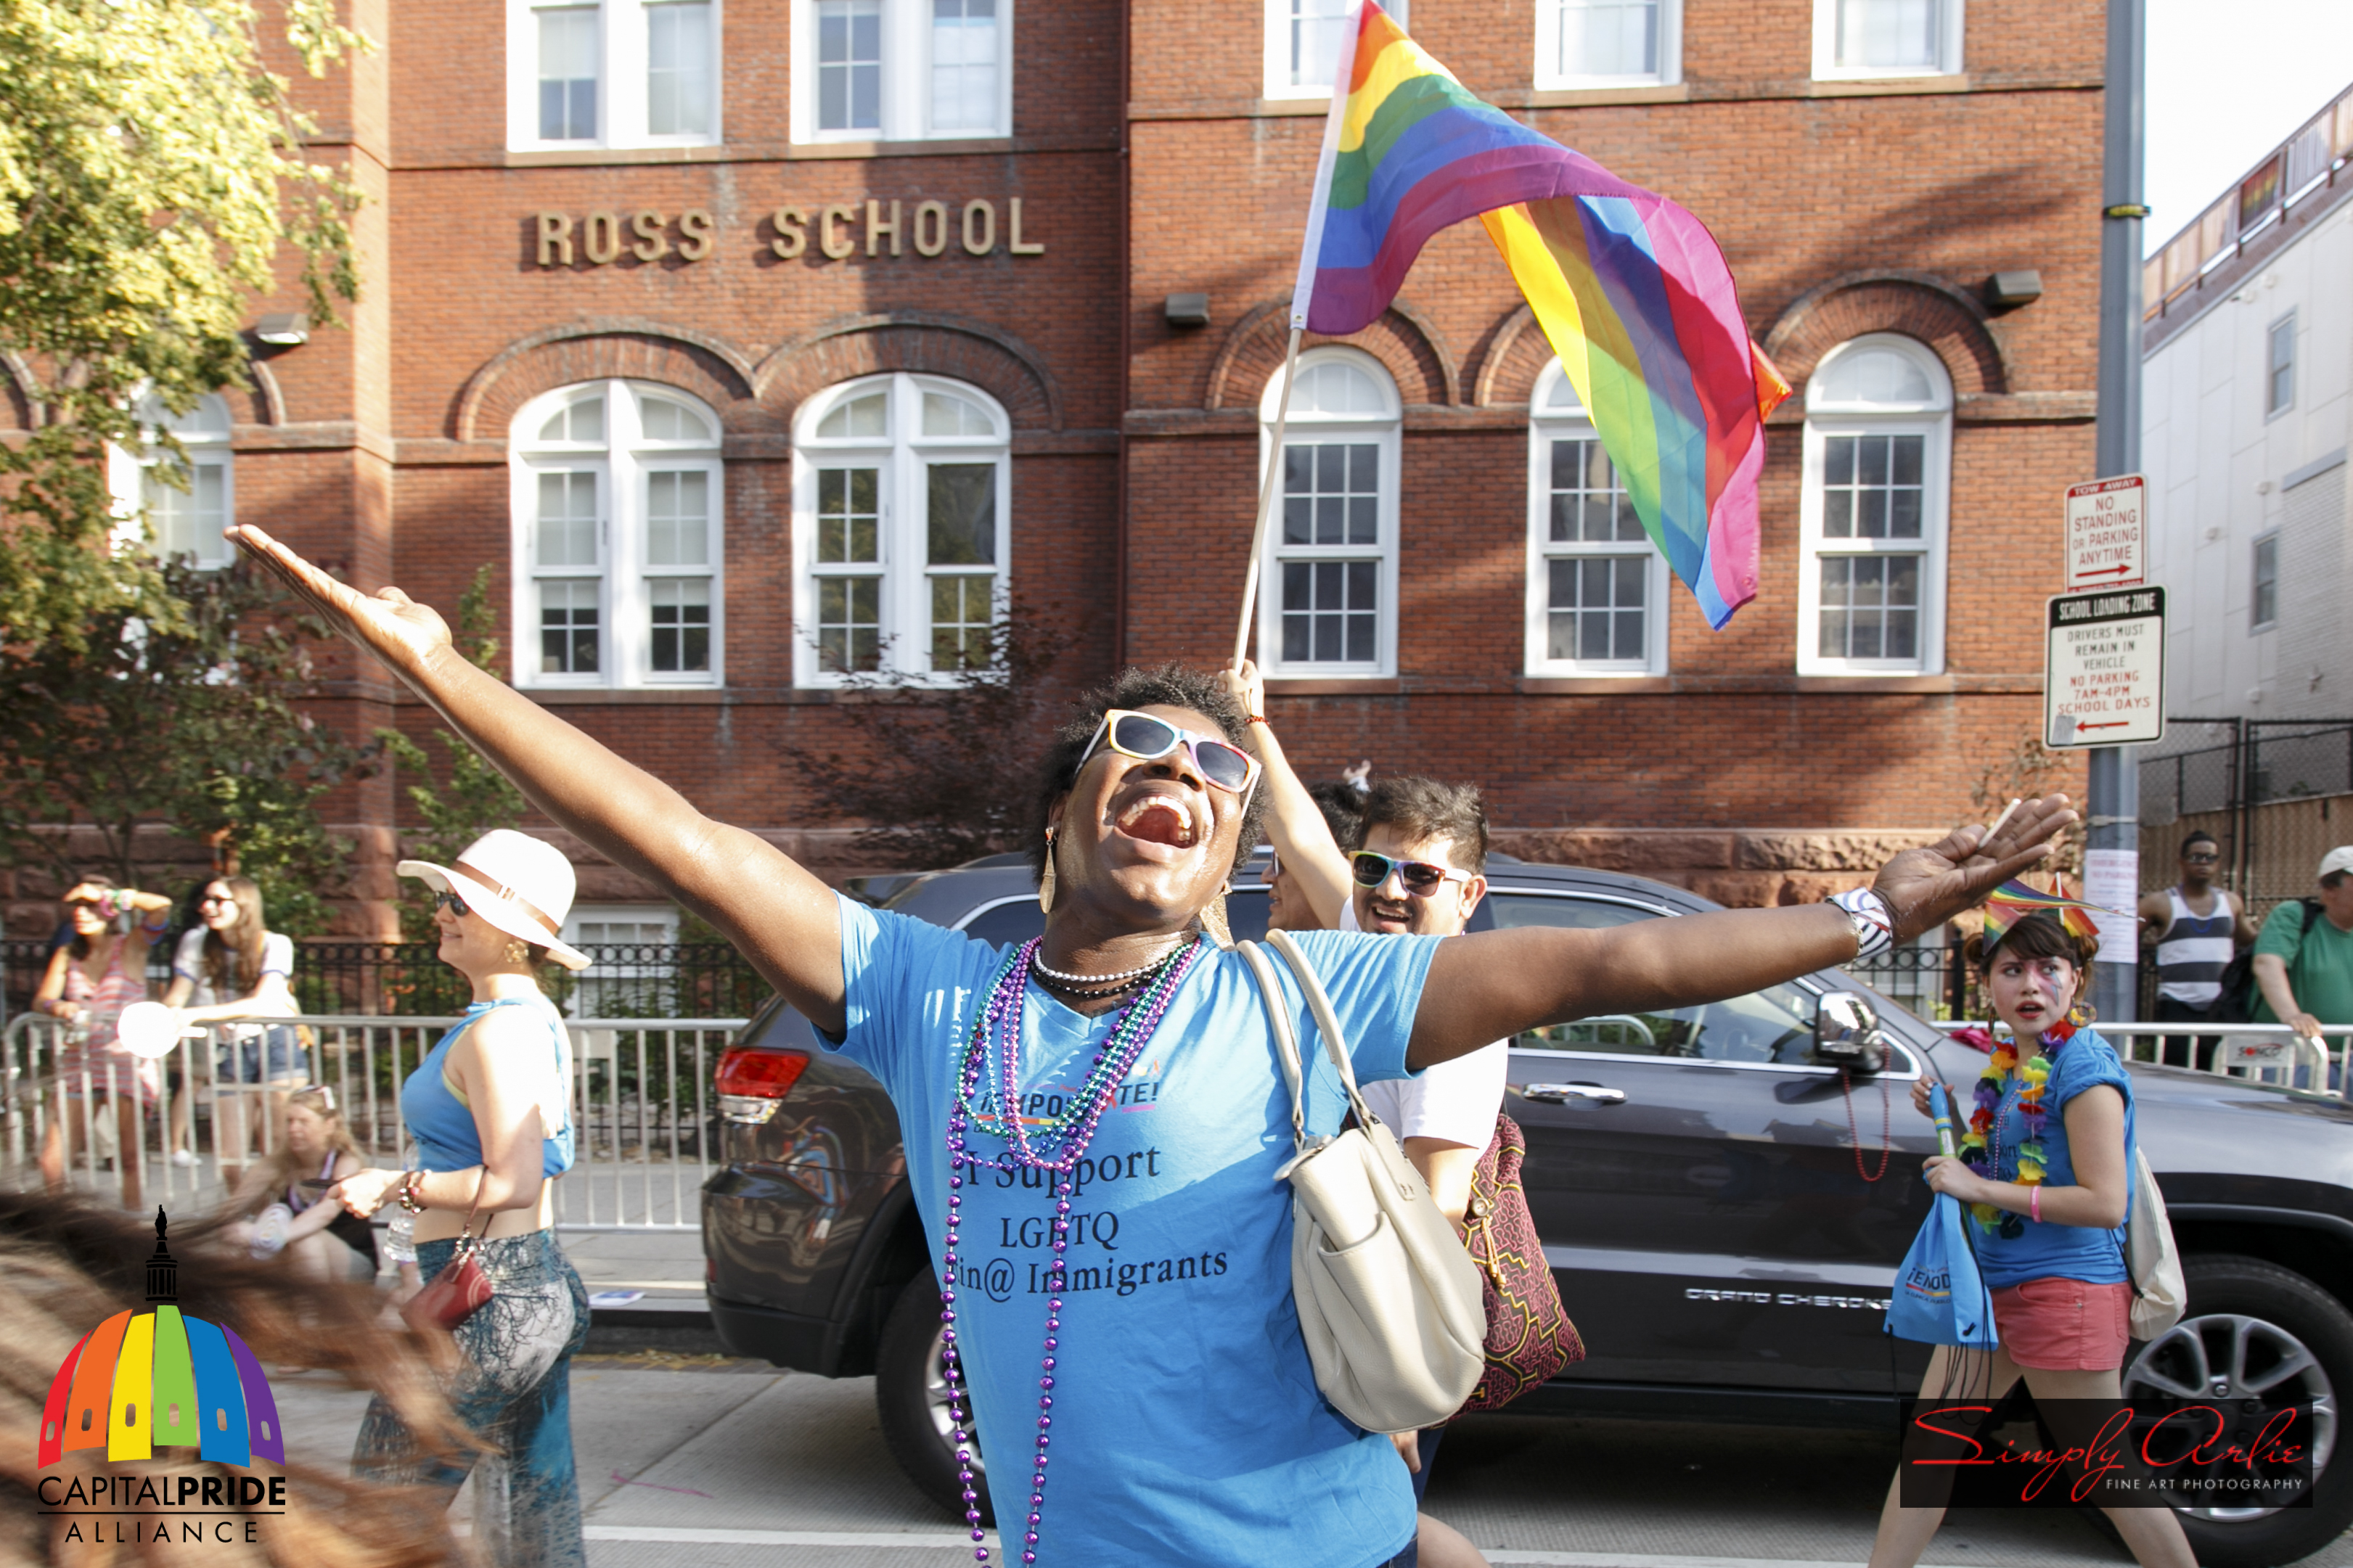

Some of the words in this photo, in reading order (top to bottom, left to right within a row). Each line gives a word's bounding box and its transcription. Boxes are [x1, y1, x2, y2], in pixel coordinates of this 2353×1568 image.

[536, 208, 713, 266] ROSS
[771, 197, 1045, 260] SCHOOL
[2074, 484, 2099, 496] TOW
[2103, 478, 2137, 493] AWAY
[2096, 496, 2113, 512] NO
[2074, 509, 2137, 533] STANDING
[2072, 538, 2084, 550] OR
[2089, 527, 2138, 548] PARKING
[2079, 545, 2132, 566] ANYTIME
[2059, 600, 2092, 620] SCHOOL
[2093, 595, 2130, 617] LOADING
[2131, 592, 2156, 612] ZONE
[2067, 627, 2111, 643] DRIVERS
[2116, 623, 2144, 637] MUST
[2075, 642, 2118, 657] REMAIN
[2124, 640, 2135, 652] IN
[2084, 656, 2125, 670] VEHICLE
[2070, 676, 2084, 687] NO
[2090, 670, 2139, 686] PARKING
[2074, 685, 2130, 700] 7AM-4PM
[2058, 701, 2109, 715] SCHOOL
[2115, 696, 2151, 710] DAYS
[967, 1151, 980, 1186] I
[996, 1146, 1161, 1199] Support
[1000, 1211, 1119, 1251] LGBTQ
[1027, 1251, 1228, 1297] Immigrants
[1685, 1288, 1771, 1303] GRAND
[1777, 1294, 1892, 1310] CHEROKE
